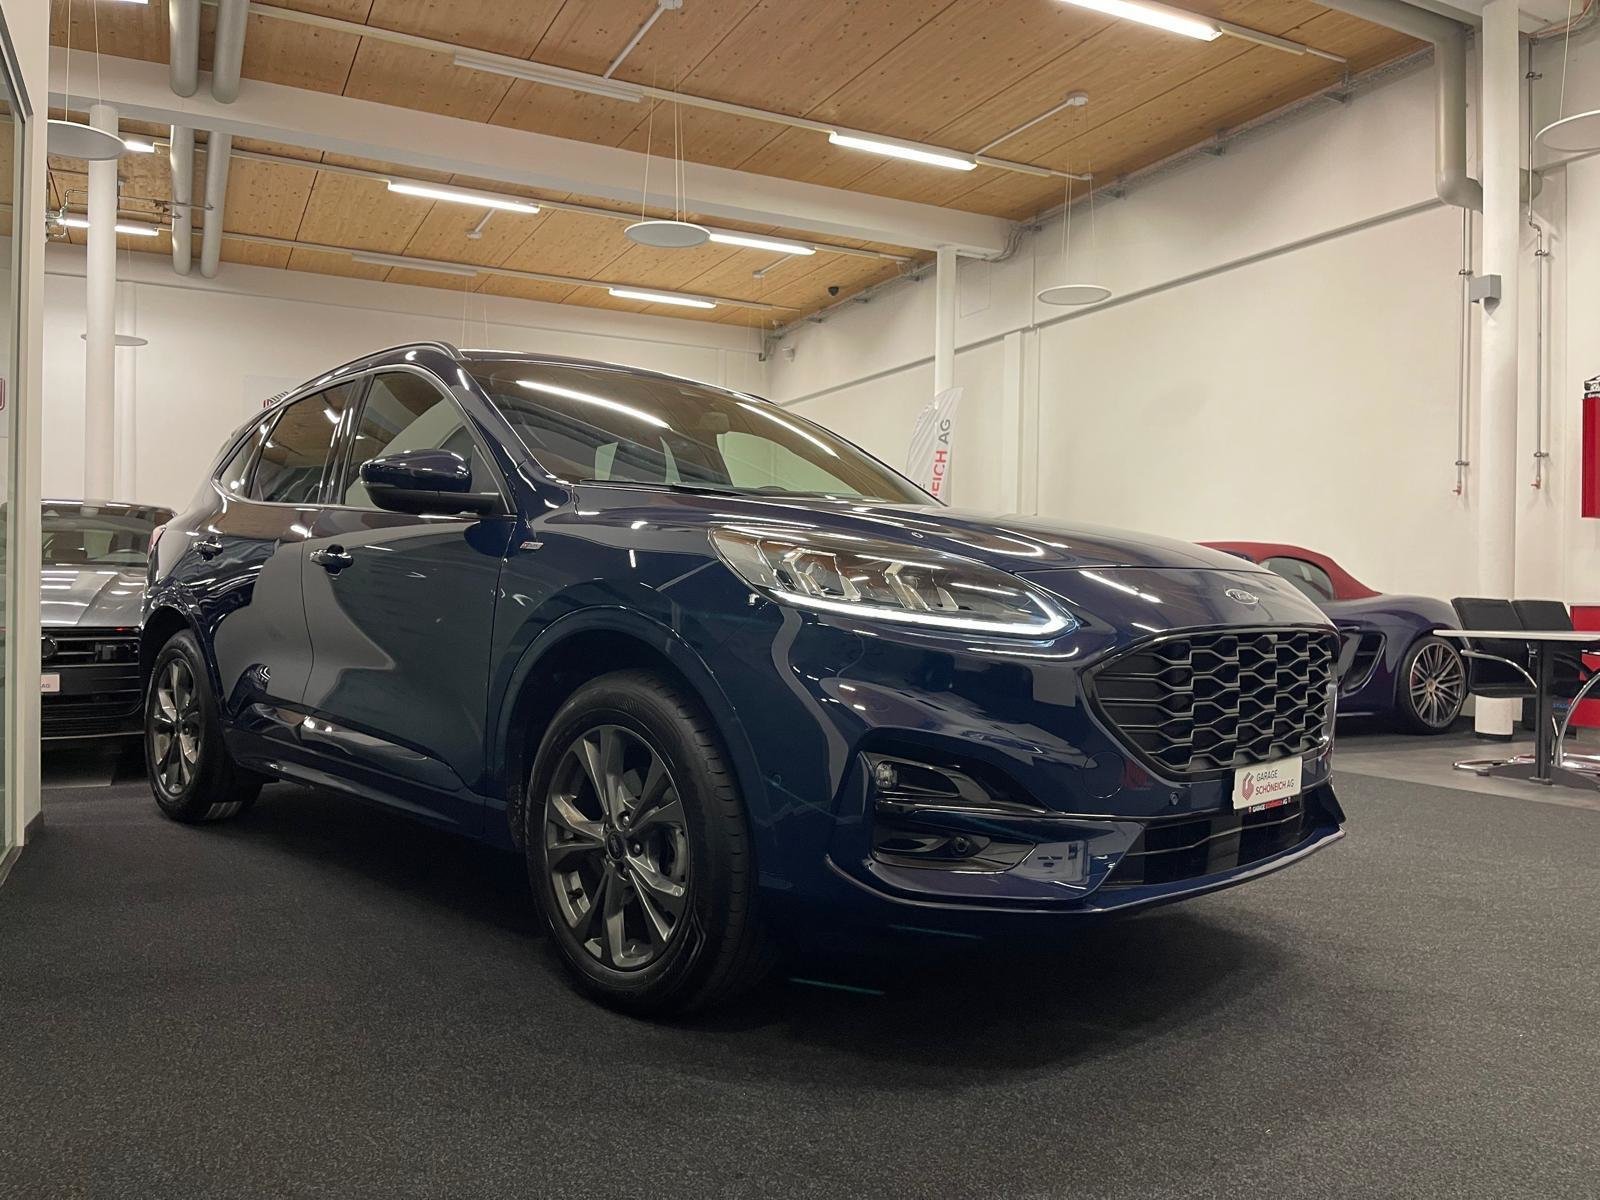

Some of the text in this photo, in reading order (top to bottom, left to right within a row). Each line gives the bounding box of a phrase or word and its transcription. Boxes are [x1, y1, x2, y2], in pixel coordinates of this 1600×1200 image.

[938, 419, 951, 444] AG
[1256, 769, 1278, 781] GARAGE
[1287, 778, 1294, 788] AG
